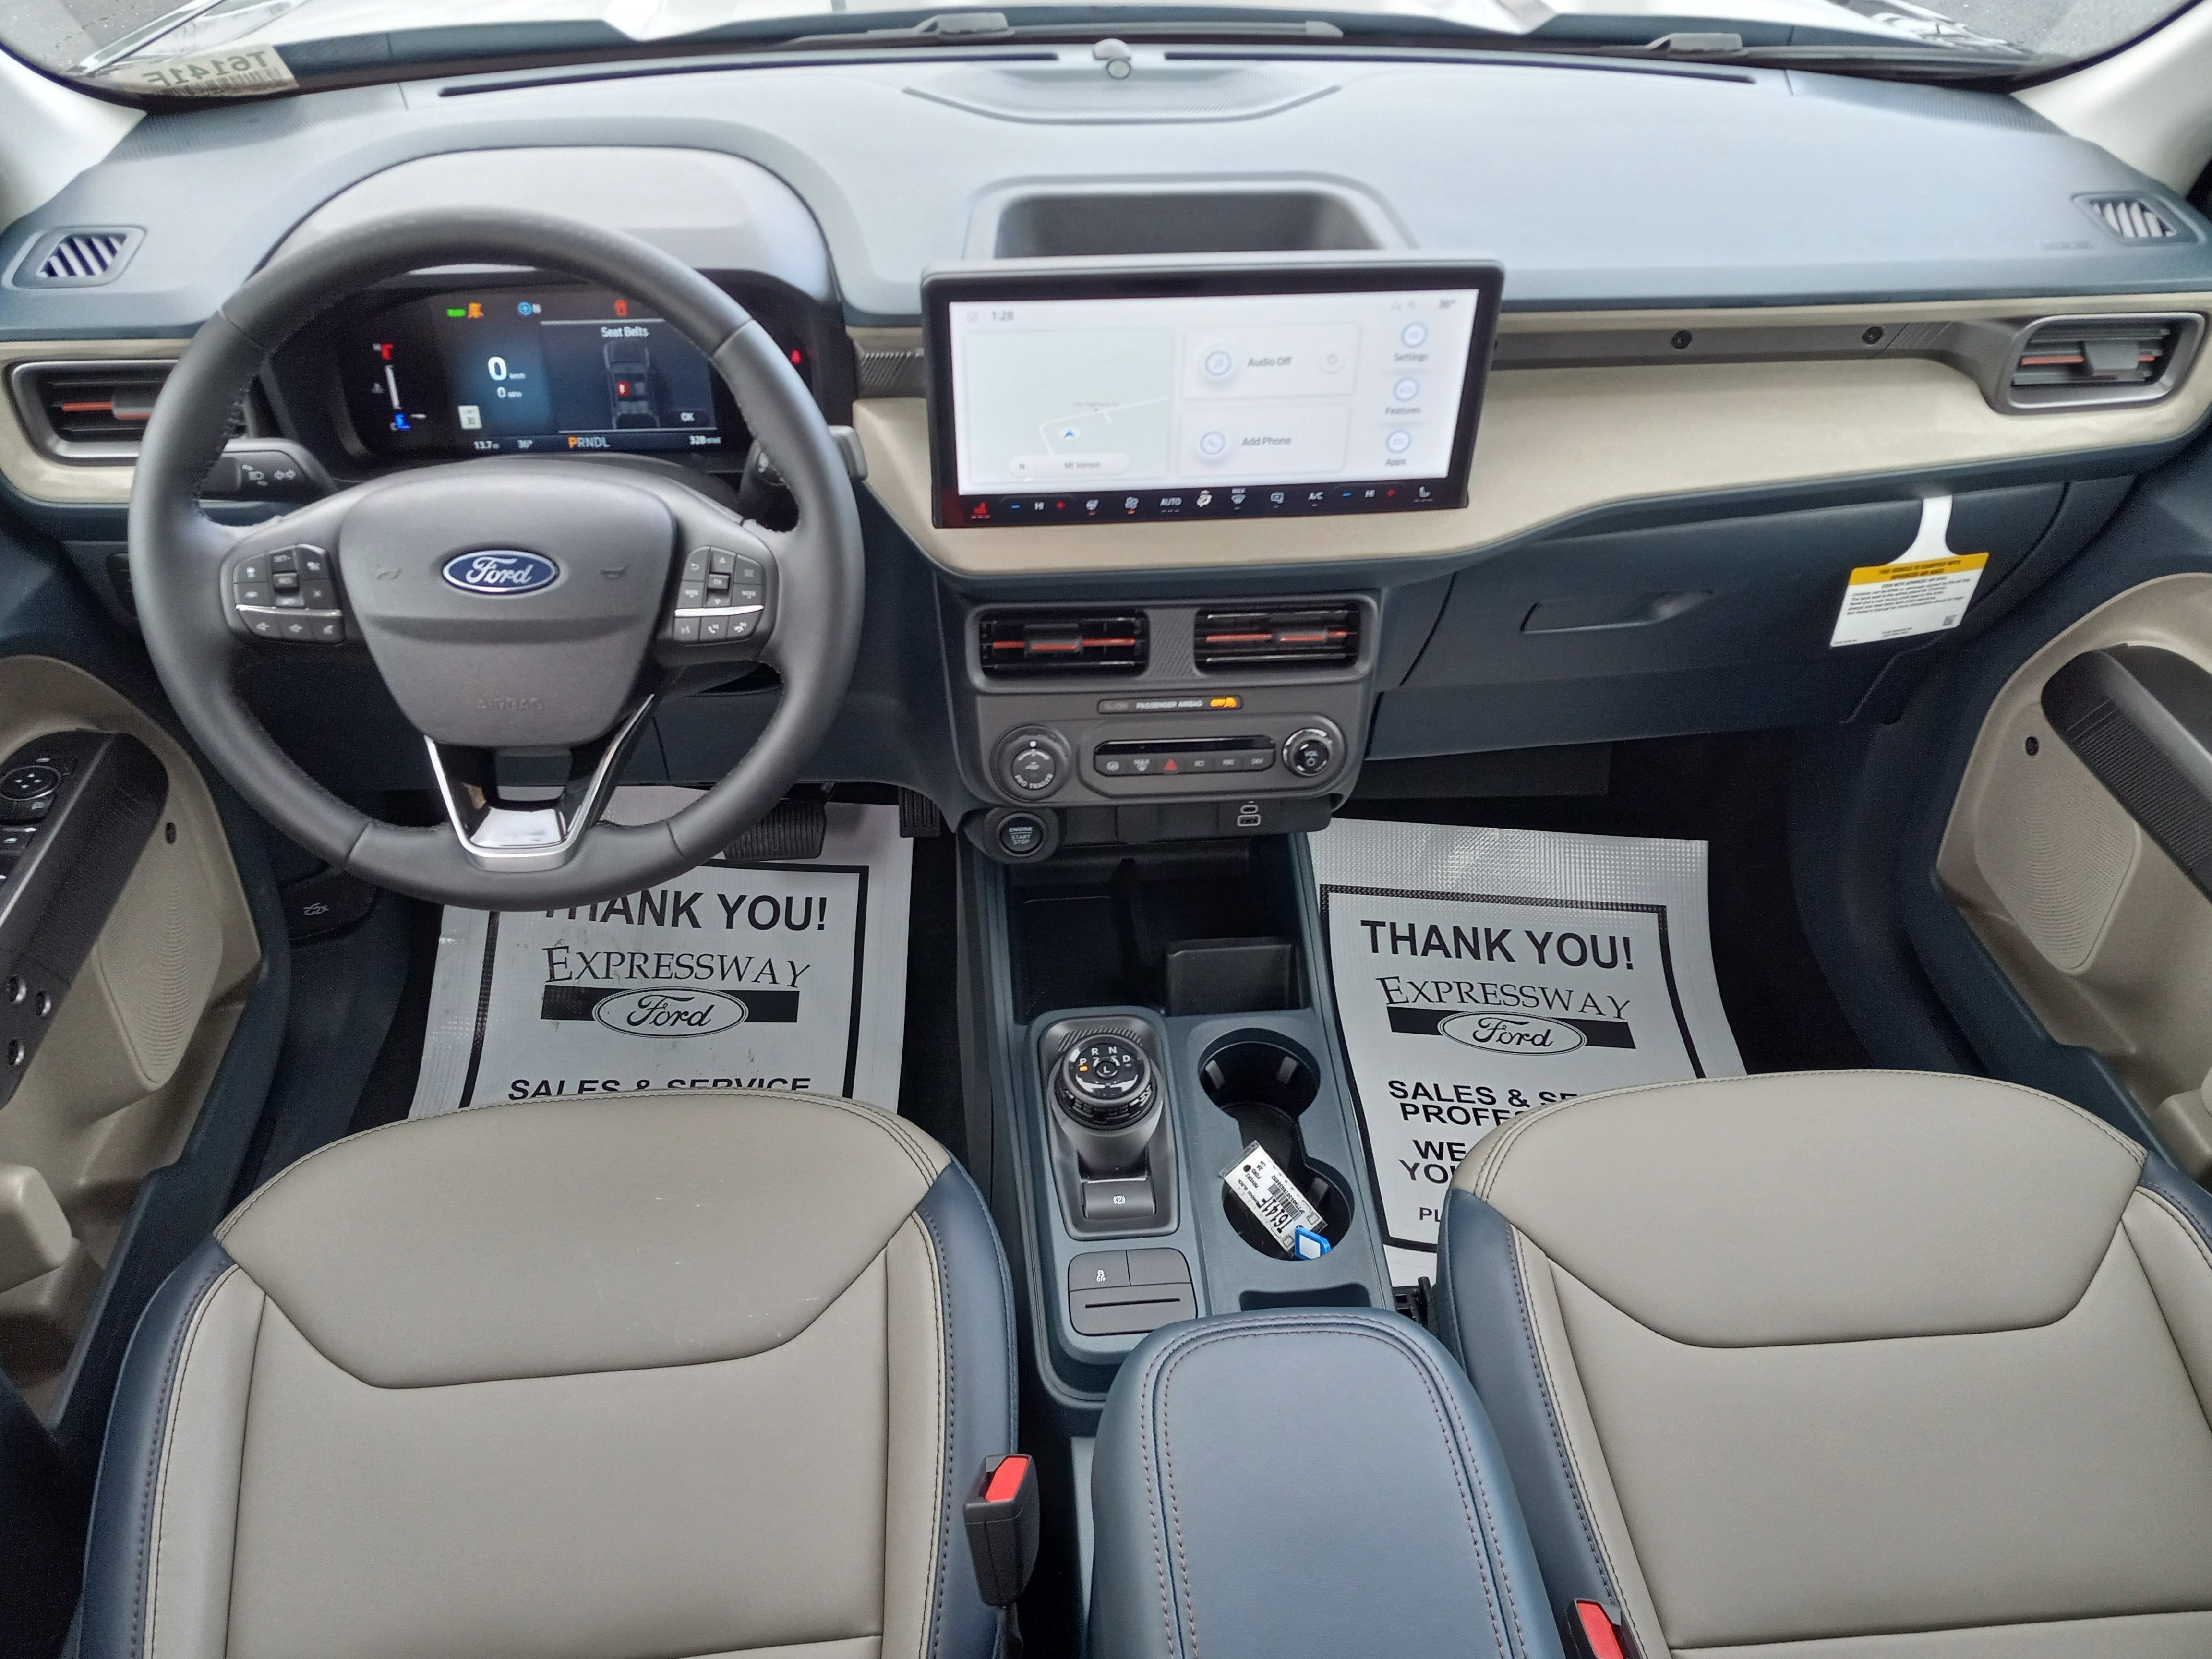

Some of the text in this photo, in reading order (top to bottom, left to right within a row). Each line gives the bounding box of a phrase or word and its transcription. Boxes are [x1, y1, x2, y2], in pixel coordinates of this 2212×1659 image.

[991, 310, 1014, 321] 1:28
[601, 326, 649, 337] Seat Belts
[1248, 356, 1292, 368] Audio Off
[1394, 353, 1429, 362] Settings
[488, 356, 507, 381] 0
[496, 386, 506, 398] 0
[680, 411, 695, 422] OK
[1241, 436, 1291, 446] Add Phone
[1385, 458, 1407, 467] Apps
[1308, 491, 1324, 501] A/C
[1365, 489, 1376, 498] HI
[1034, 501, 1045, 510] HI
[1159, 496, 1182, 507] AUTO
[465, 556, 534, 584] Ford
[1014, 773, 1054, 789] PRO TRAILER
[717, 893, 828, 931] YOU!
[1360, 919, 1634, 970] THANK YOU!
[542, 945, 811, 988] EXPRESSWAY
[1375, 975, 1631, 1021] EXPRESSWAY
[626, 994, 716, 1027] Ford
[1472, 1016, 1554, 1047] Ford
[1091, 1047, 1100, 1056] R
[1108, 1046, 1117, 1054] N
[1122, 1055, 1131, 1063] D
[1388, 1080, 1497, 1105] SALES
[1507, 1089, 1532, 1108] &
[1400, 1102, 1526, 1127] PROFE
[1412, 1139, 1467, 1162] WE
[1251, 1168, 1262, 1180] FORD
[1398, 1158, 1457, 1184] YO
[1238, 1179, 1249, 1191] BLACK
[1246, 1172, 1259, 1188] MAVERI
[1255, 1196, 1295, 1234] T6141F
